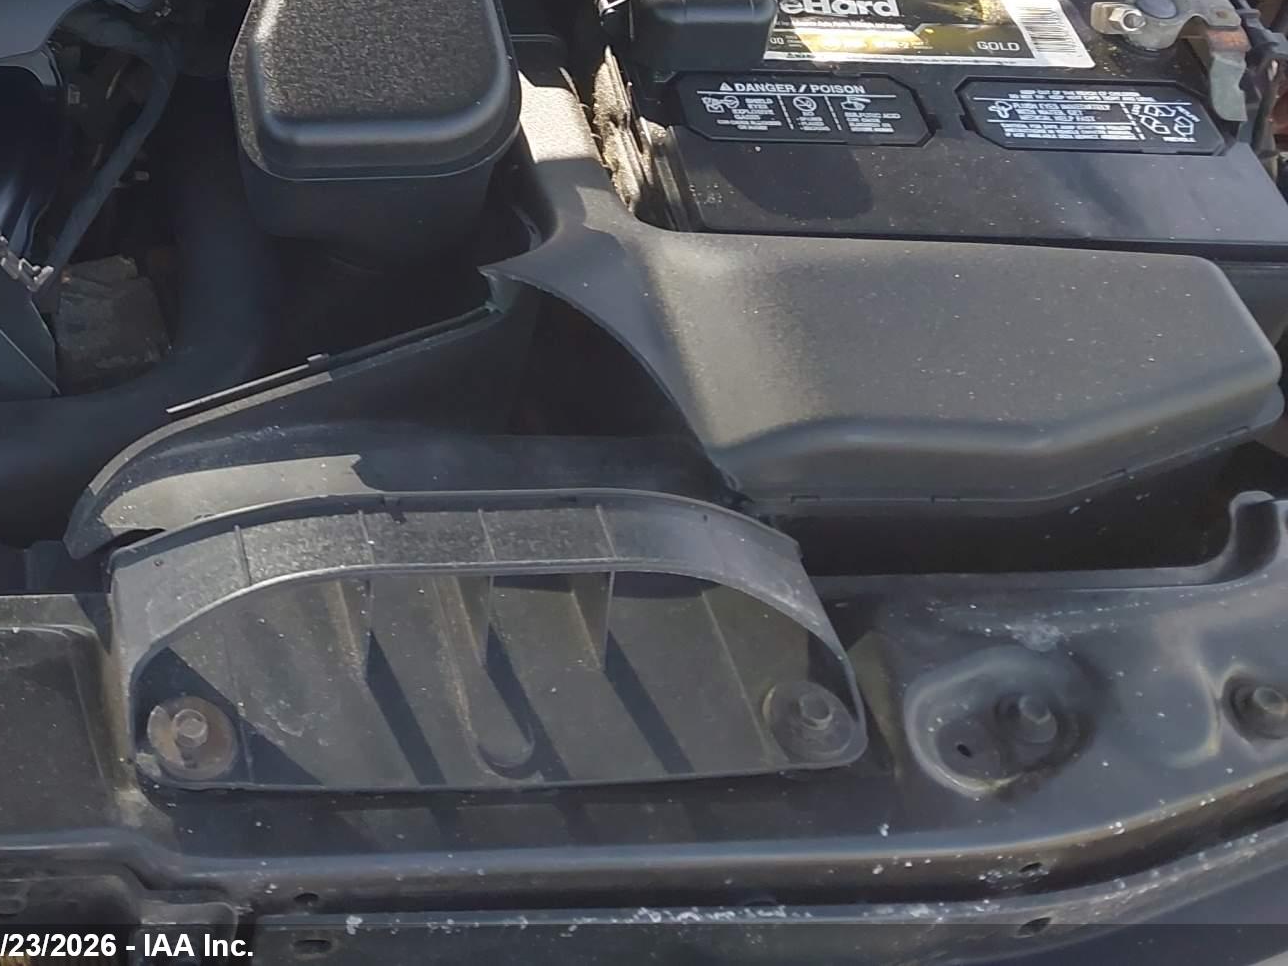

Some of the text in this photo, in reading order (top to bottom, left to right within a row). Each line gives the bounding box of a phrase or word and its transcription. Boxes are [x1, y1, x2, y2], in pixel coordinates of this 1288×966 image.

[976, 41, 1021, 51] GOLD
[734, 83, 797, 94] DANGER
[810, 84, 866, 94] POISON
